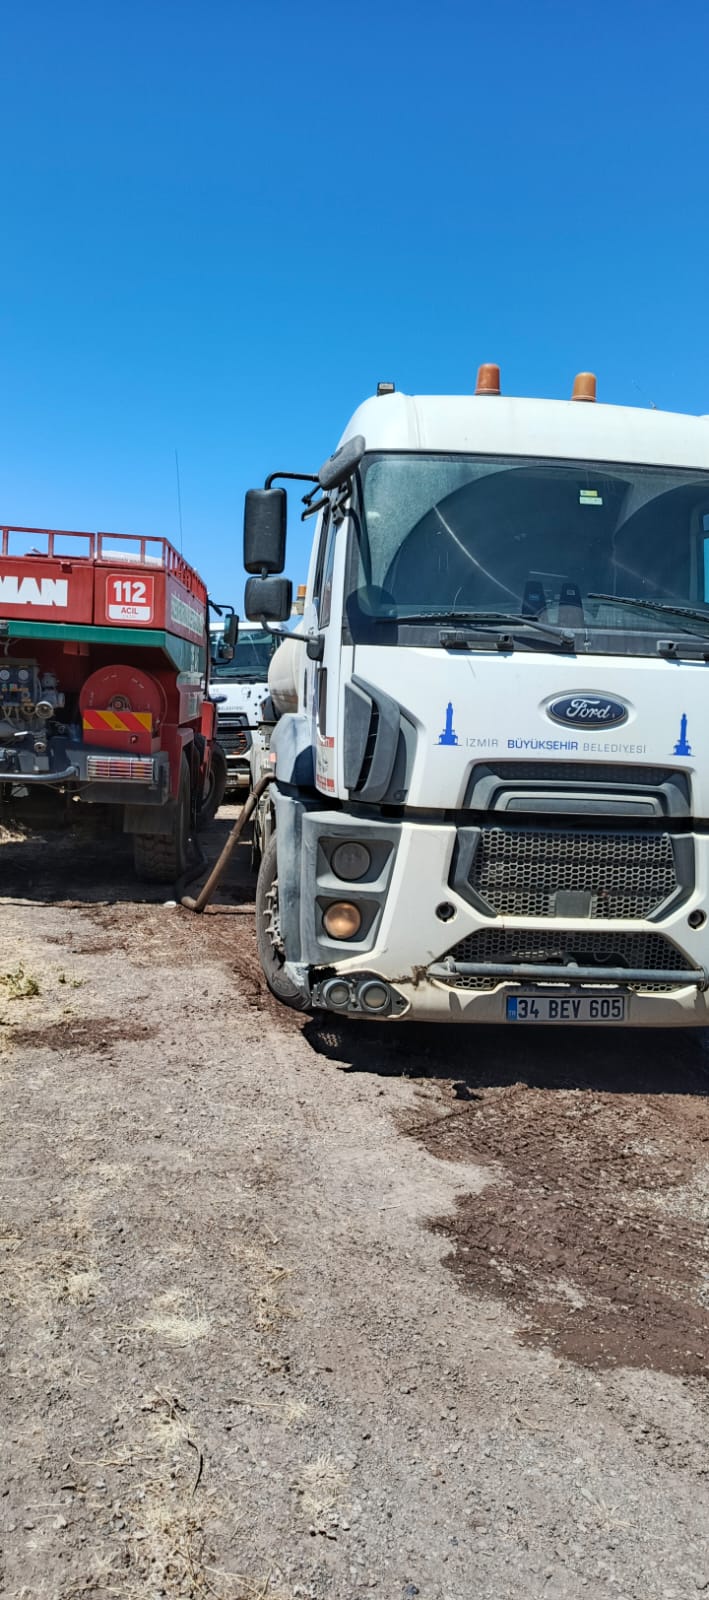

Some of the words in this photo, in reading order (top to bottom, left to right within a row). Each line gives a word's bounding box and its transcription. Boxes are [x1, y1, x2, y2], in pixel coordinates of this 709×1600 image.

[113, 580, 147, 603] 112
[566, 698, 612, 719] Ford
[518, 1000, 540, 1019] 34
[549, 1000, 581, 1019] BEV
[590, 999, 621, 1018] 605
